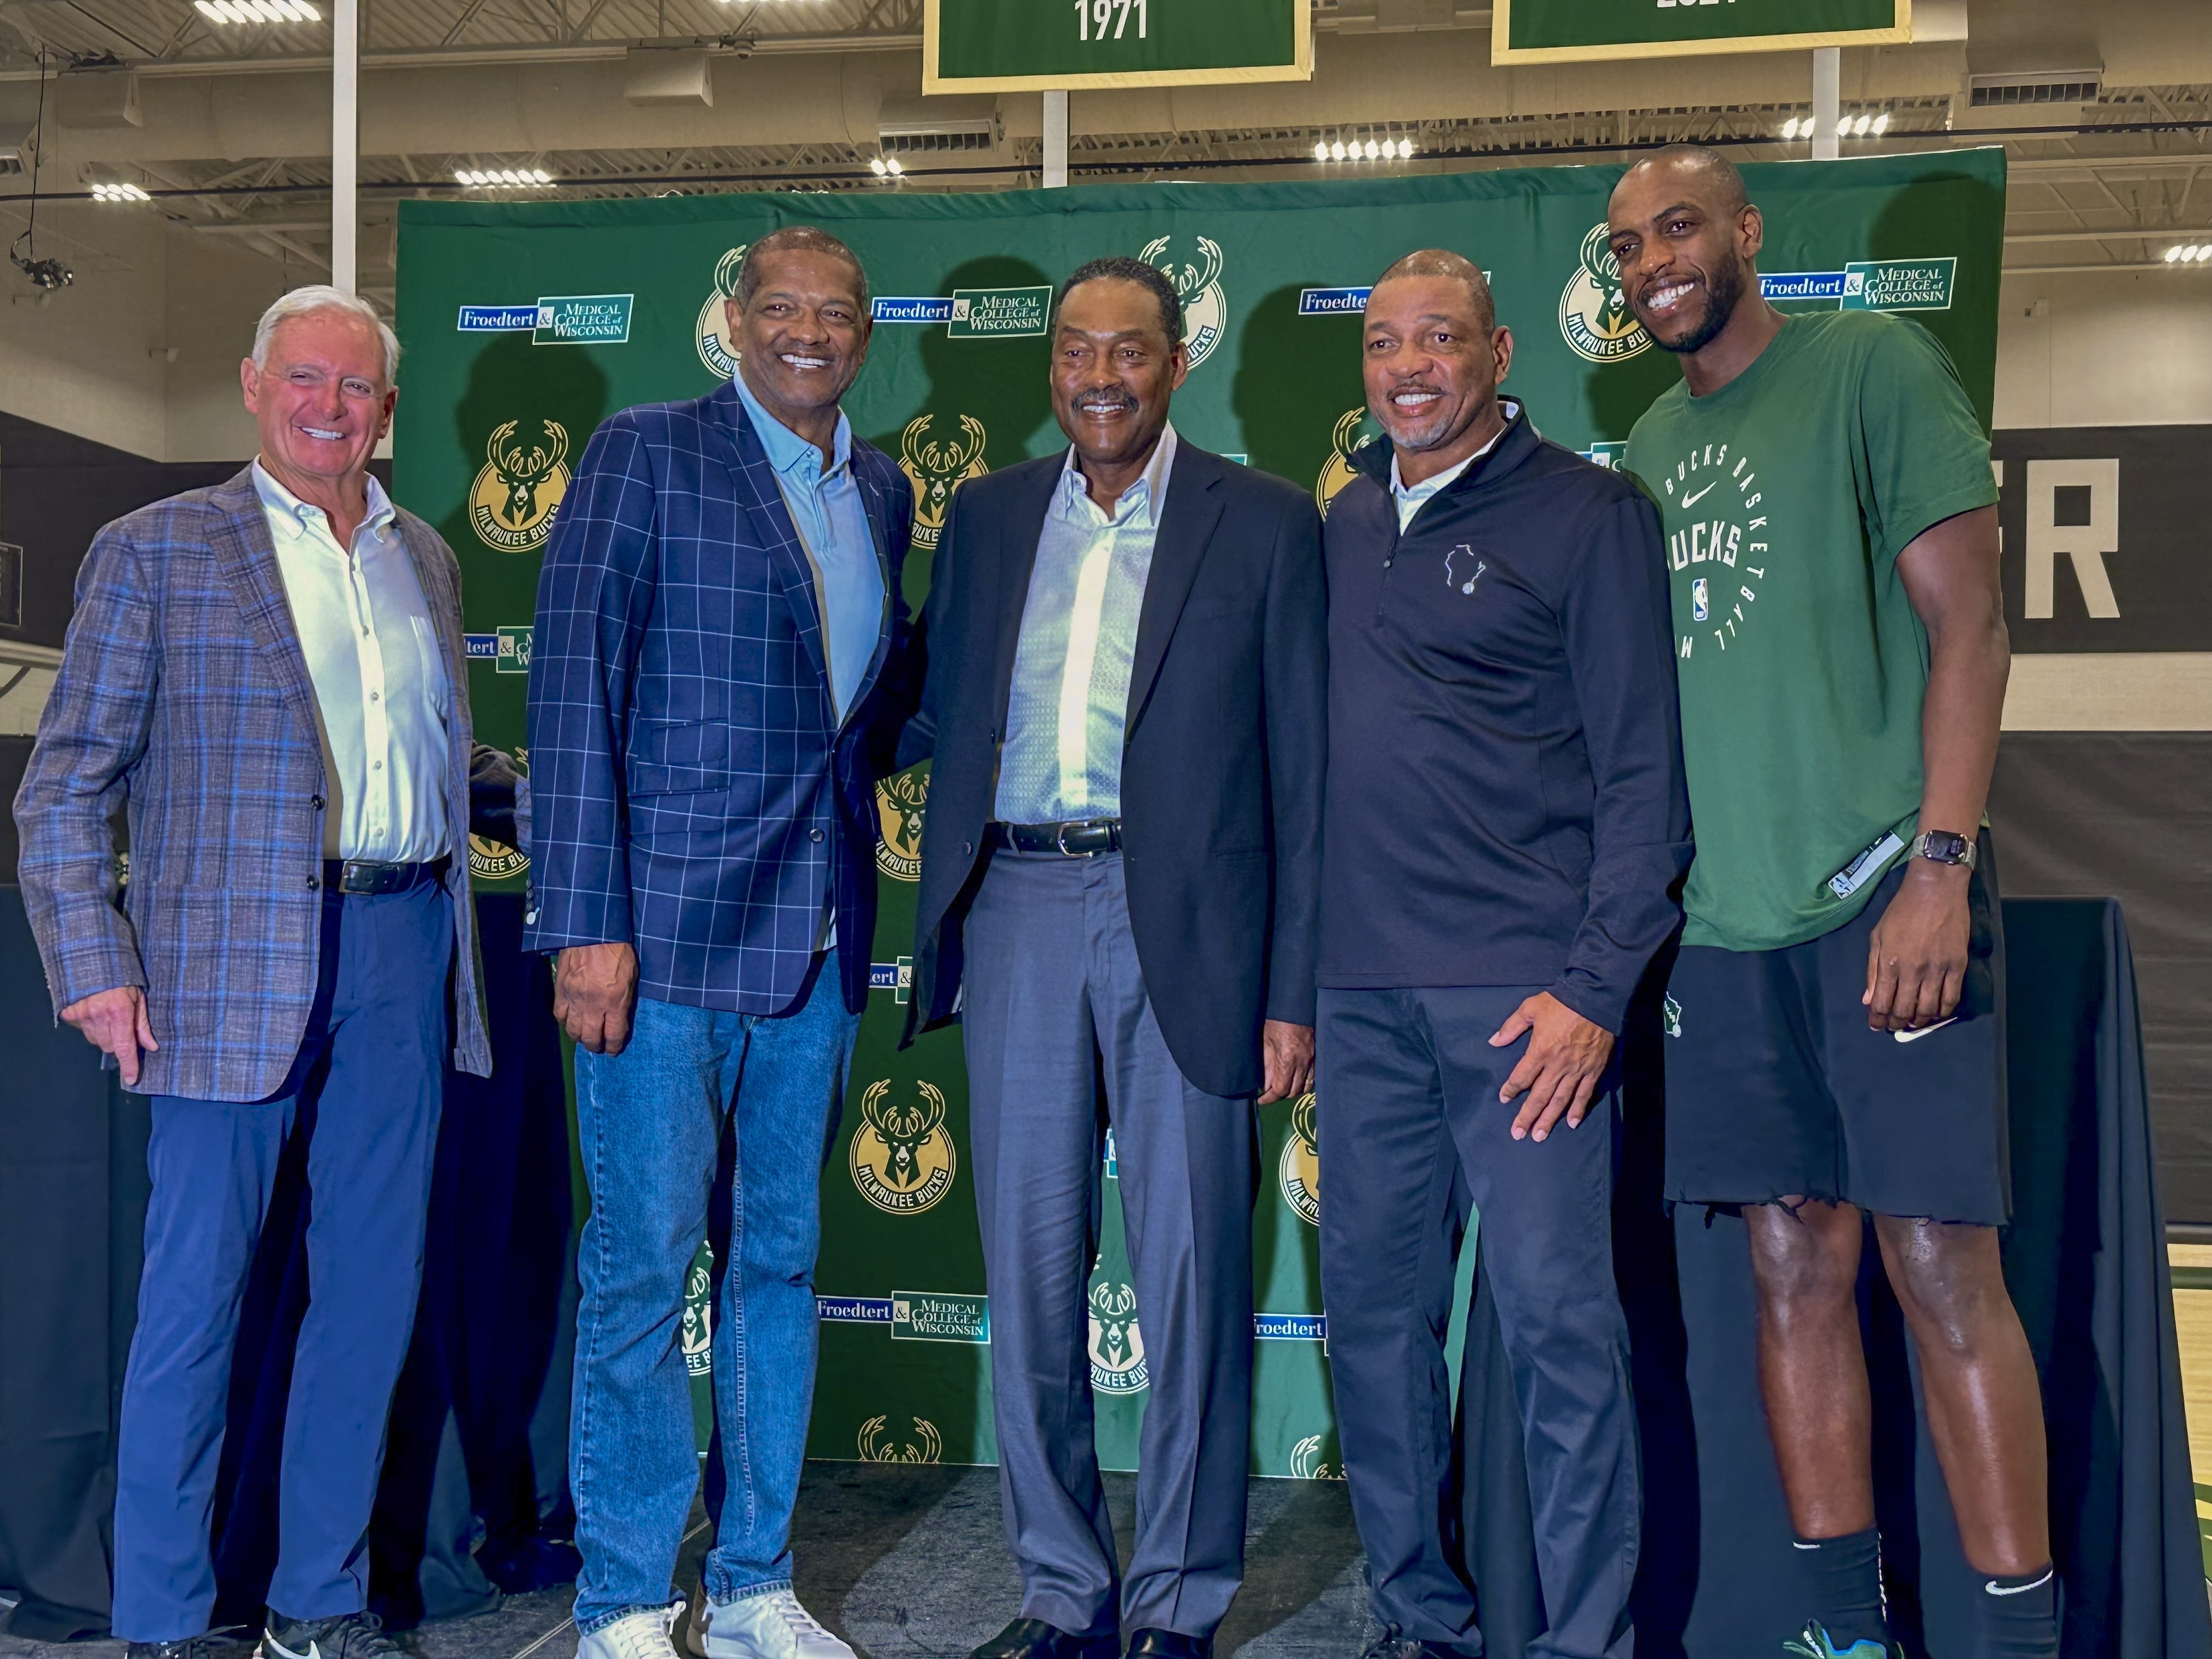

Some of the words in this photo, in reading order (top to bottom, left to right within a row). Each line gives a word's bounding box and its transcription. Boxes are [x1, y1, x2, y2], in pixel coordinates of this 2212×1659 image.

[1074, 0, 1147, 41] 1971
[1877, 268, 1942, 281] MEDICAL
[1760, 278, 1841, 295] Froedtert
[1846, 279, 1860, 292] &
[1865, 279, 1931, 293] COLLEGE
[981, 296, 1040, 308] MEDICAL
[1306, 292, 1367, 310] Froedte
[1864, 291, 1945, 305] WISCONSIN
[565, 303, 621, 316] MEDICAL
[877, 302, 949, 318] Froedtert
[955, 305, 966, 317] &
[970, 306, 1030, 319] COLLEGE
[464, 311, 534, 327] Froedtert
[539, 312, 550, 325] &
[555, 313, 611, 325] COLLEGE
[969, 317, 1041, 330] WISCONSIN
[554, 324, 623, 337] WISCONSIN
[1567, 315, 1624, 355] MILWAUKEE
[1187, 328, 1215, 362] UCKS
[477, 506, 527, 545] MILWAUKEE
[1665, 444, 1728, 495] BUCKS
[1714, 456, 1768, 651] BASKETBALL
[1671, 520, 1741, 571] UCKS
[858, 1166, 915, 1207] MILWAUKEE
[916, 1169, 947, 1204] BUCKS
[896, 1306, 907, 1319] &
[922, 1299, 979, 1314] MEDICAL
[911, 1309, 971, 1324] COLLEGE
[911, 1319, 984, 1336] WISCONSIN
[1254, 1318, 1323, 1335] roedtert
